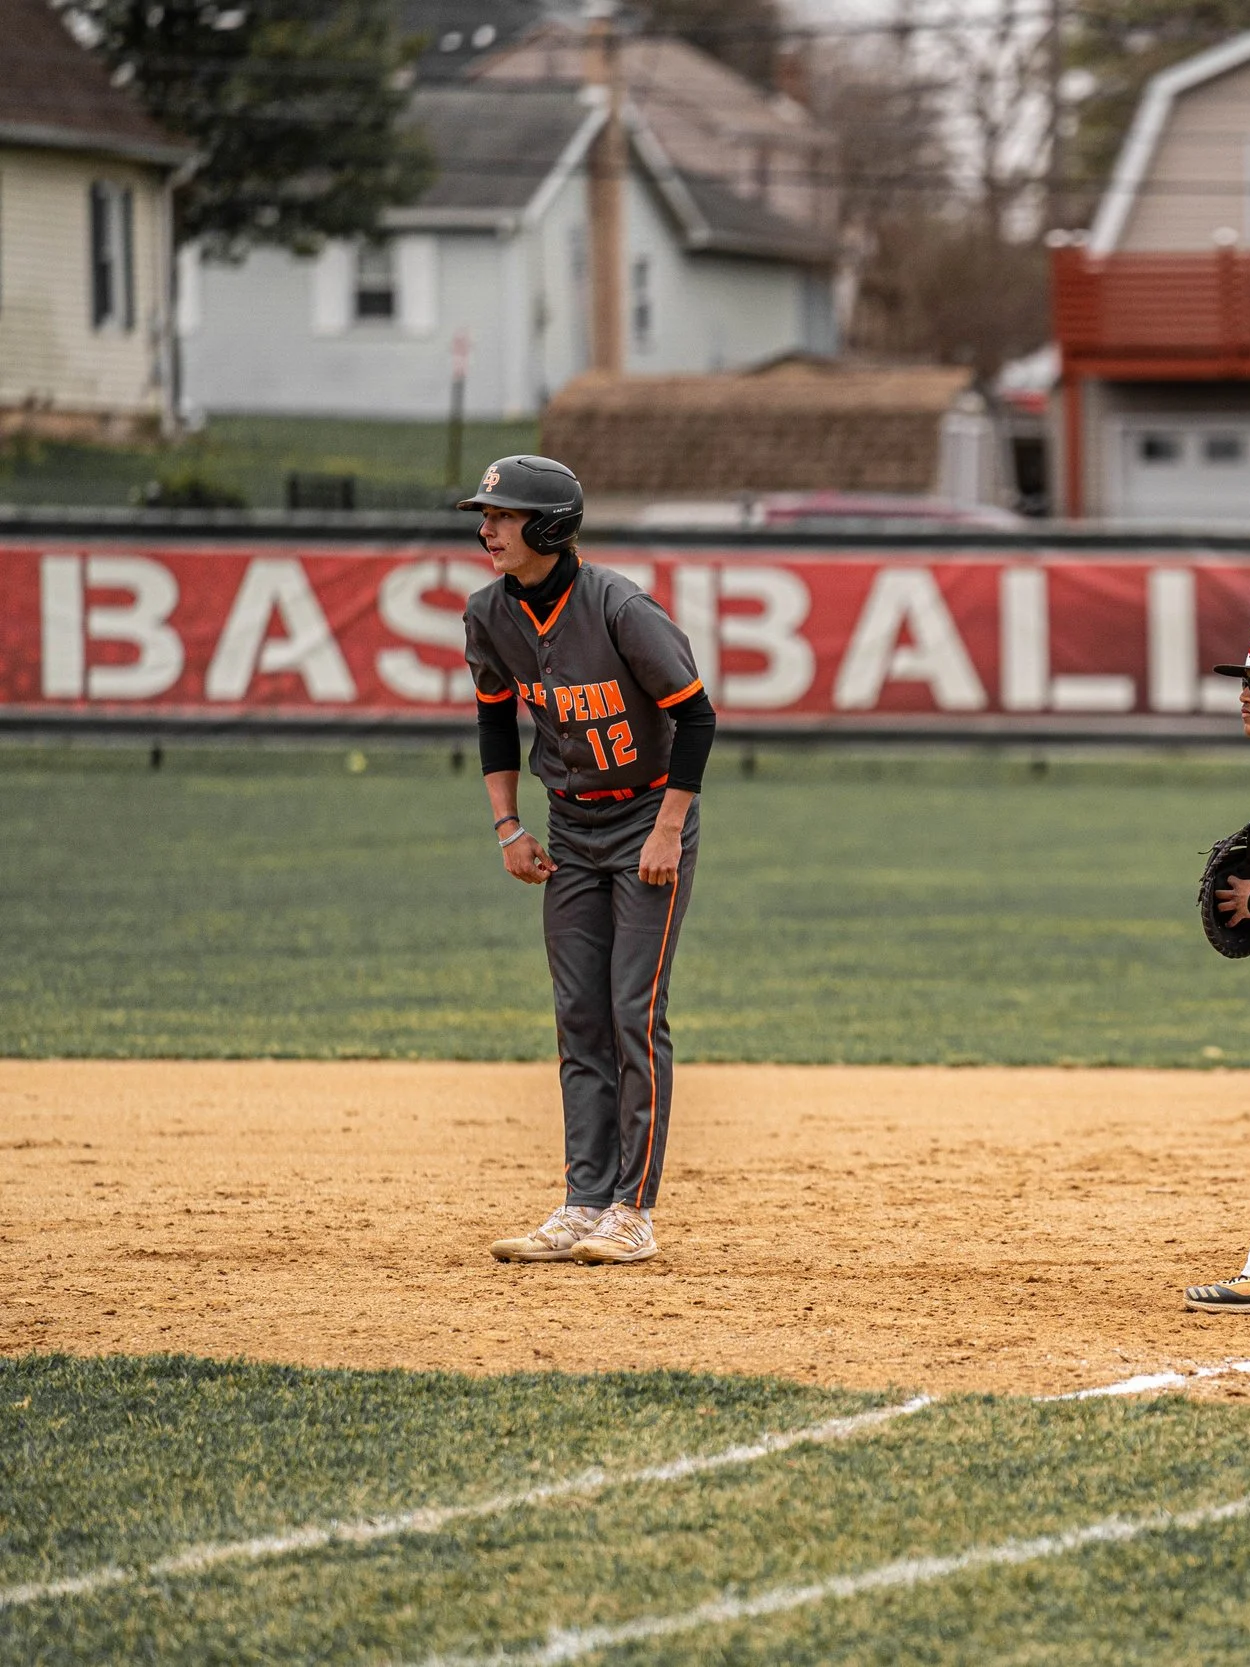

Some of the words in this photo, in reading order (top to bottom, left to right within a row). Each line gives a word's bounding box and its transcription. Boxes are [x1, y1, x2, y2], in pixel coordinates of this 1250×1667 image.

[40, 554, 1244, 713] BASBALL
[553, 680, 626, 722] PENN
[586, 720, 637, 770] 12
